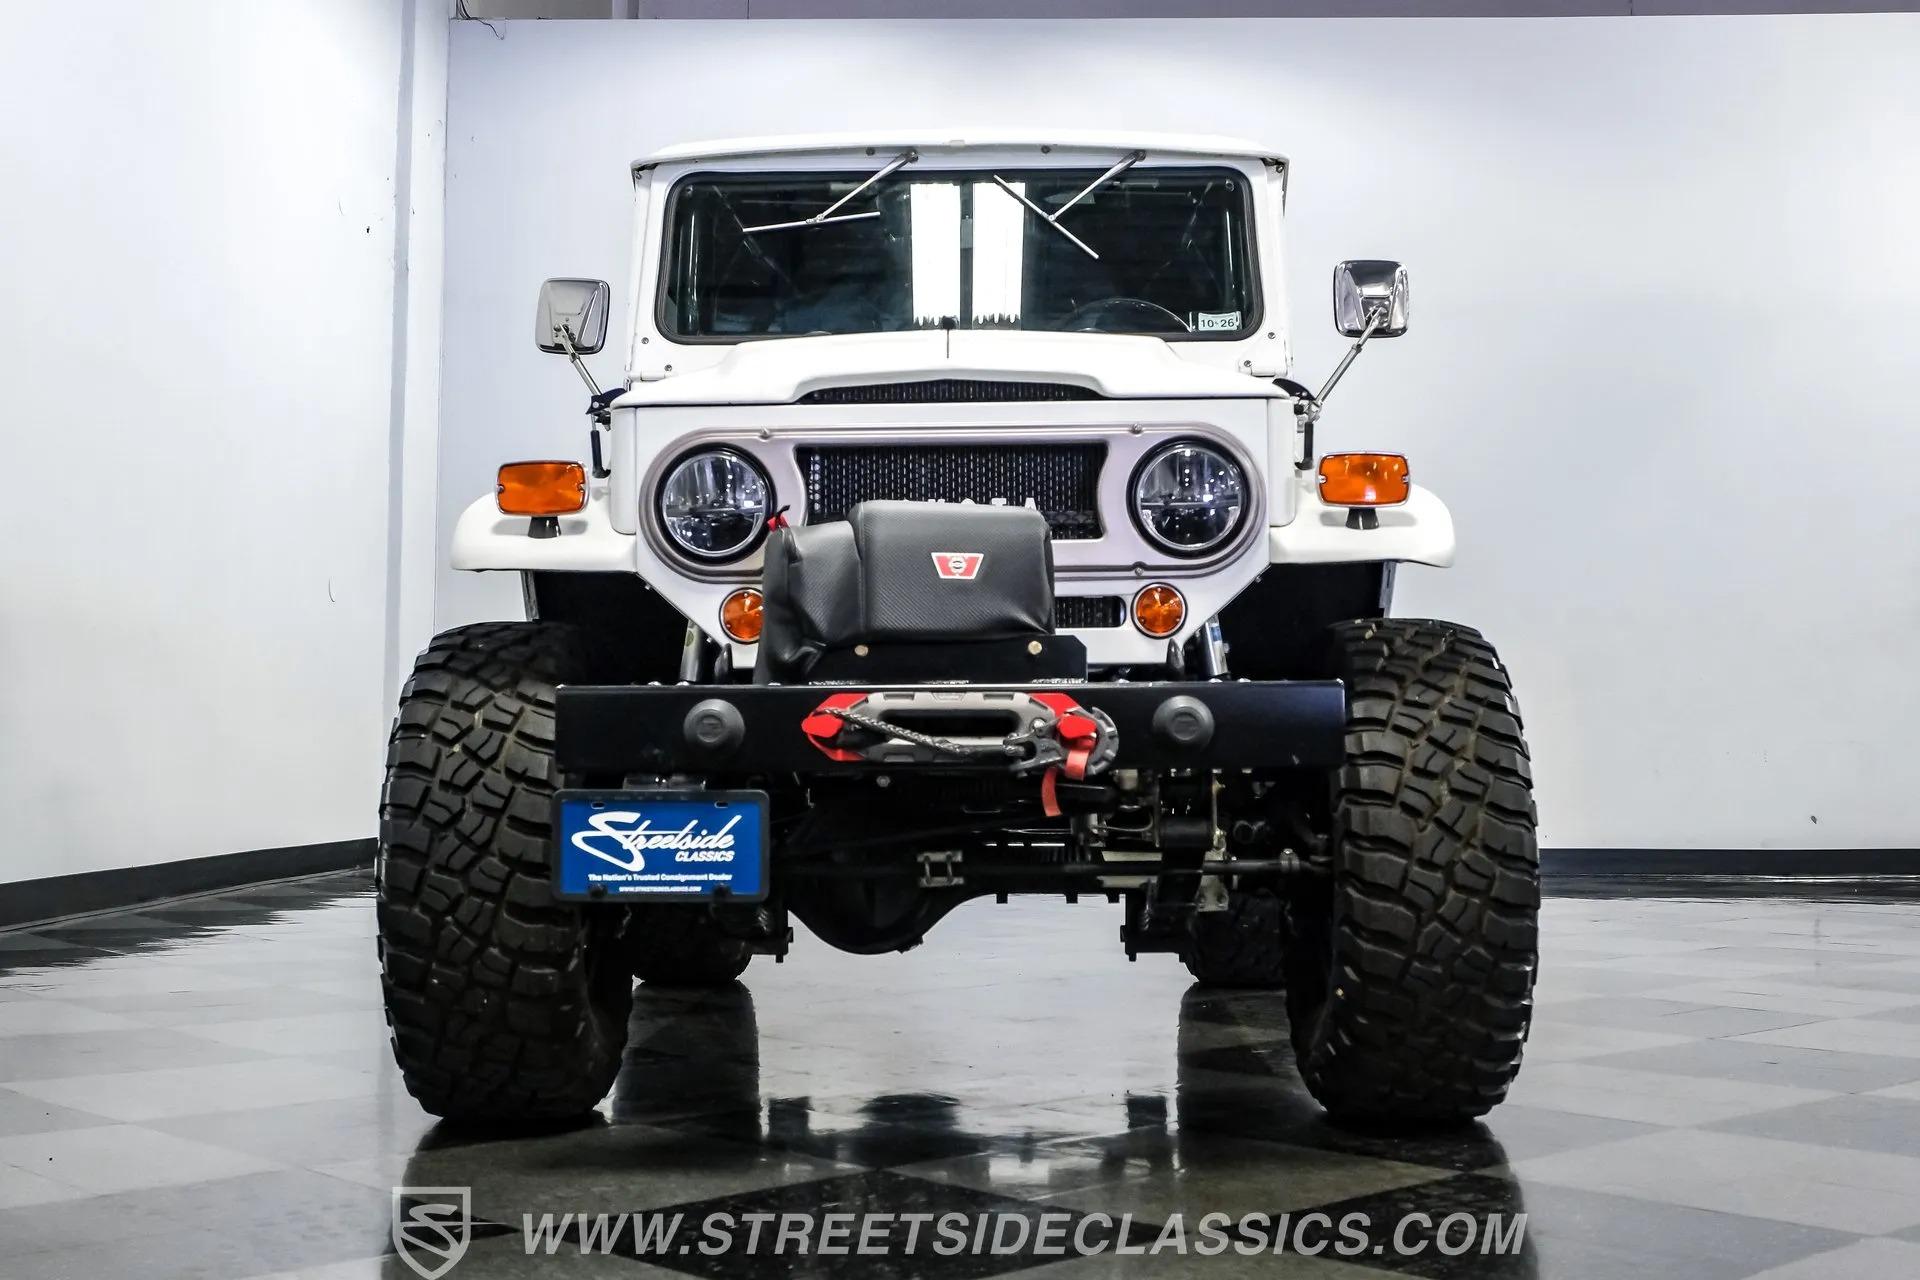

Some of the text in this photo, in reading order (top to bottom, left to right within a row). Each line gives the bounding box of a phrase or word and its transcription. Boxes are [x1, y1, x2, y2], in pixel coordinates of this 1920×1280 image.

[571, 811, 742, 872] Streetside
[675, 851, 735, 863] CLASSICS
[661, 873, 708, 882] Consignment
[708, 873, 732, 881] Dealer
